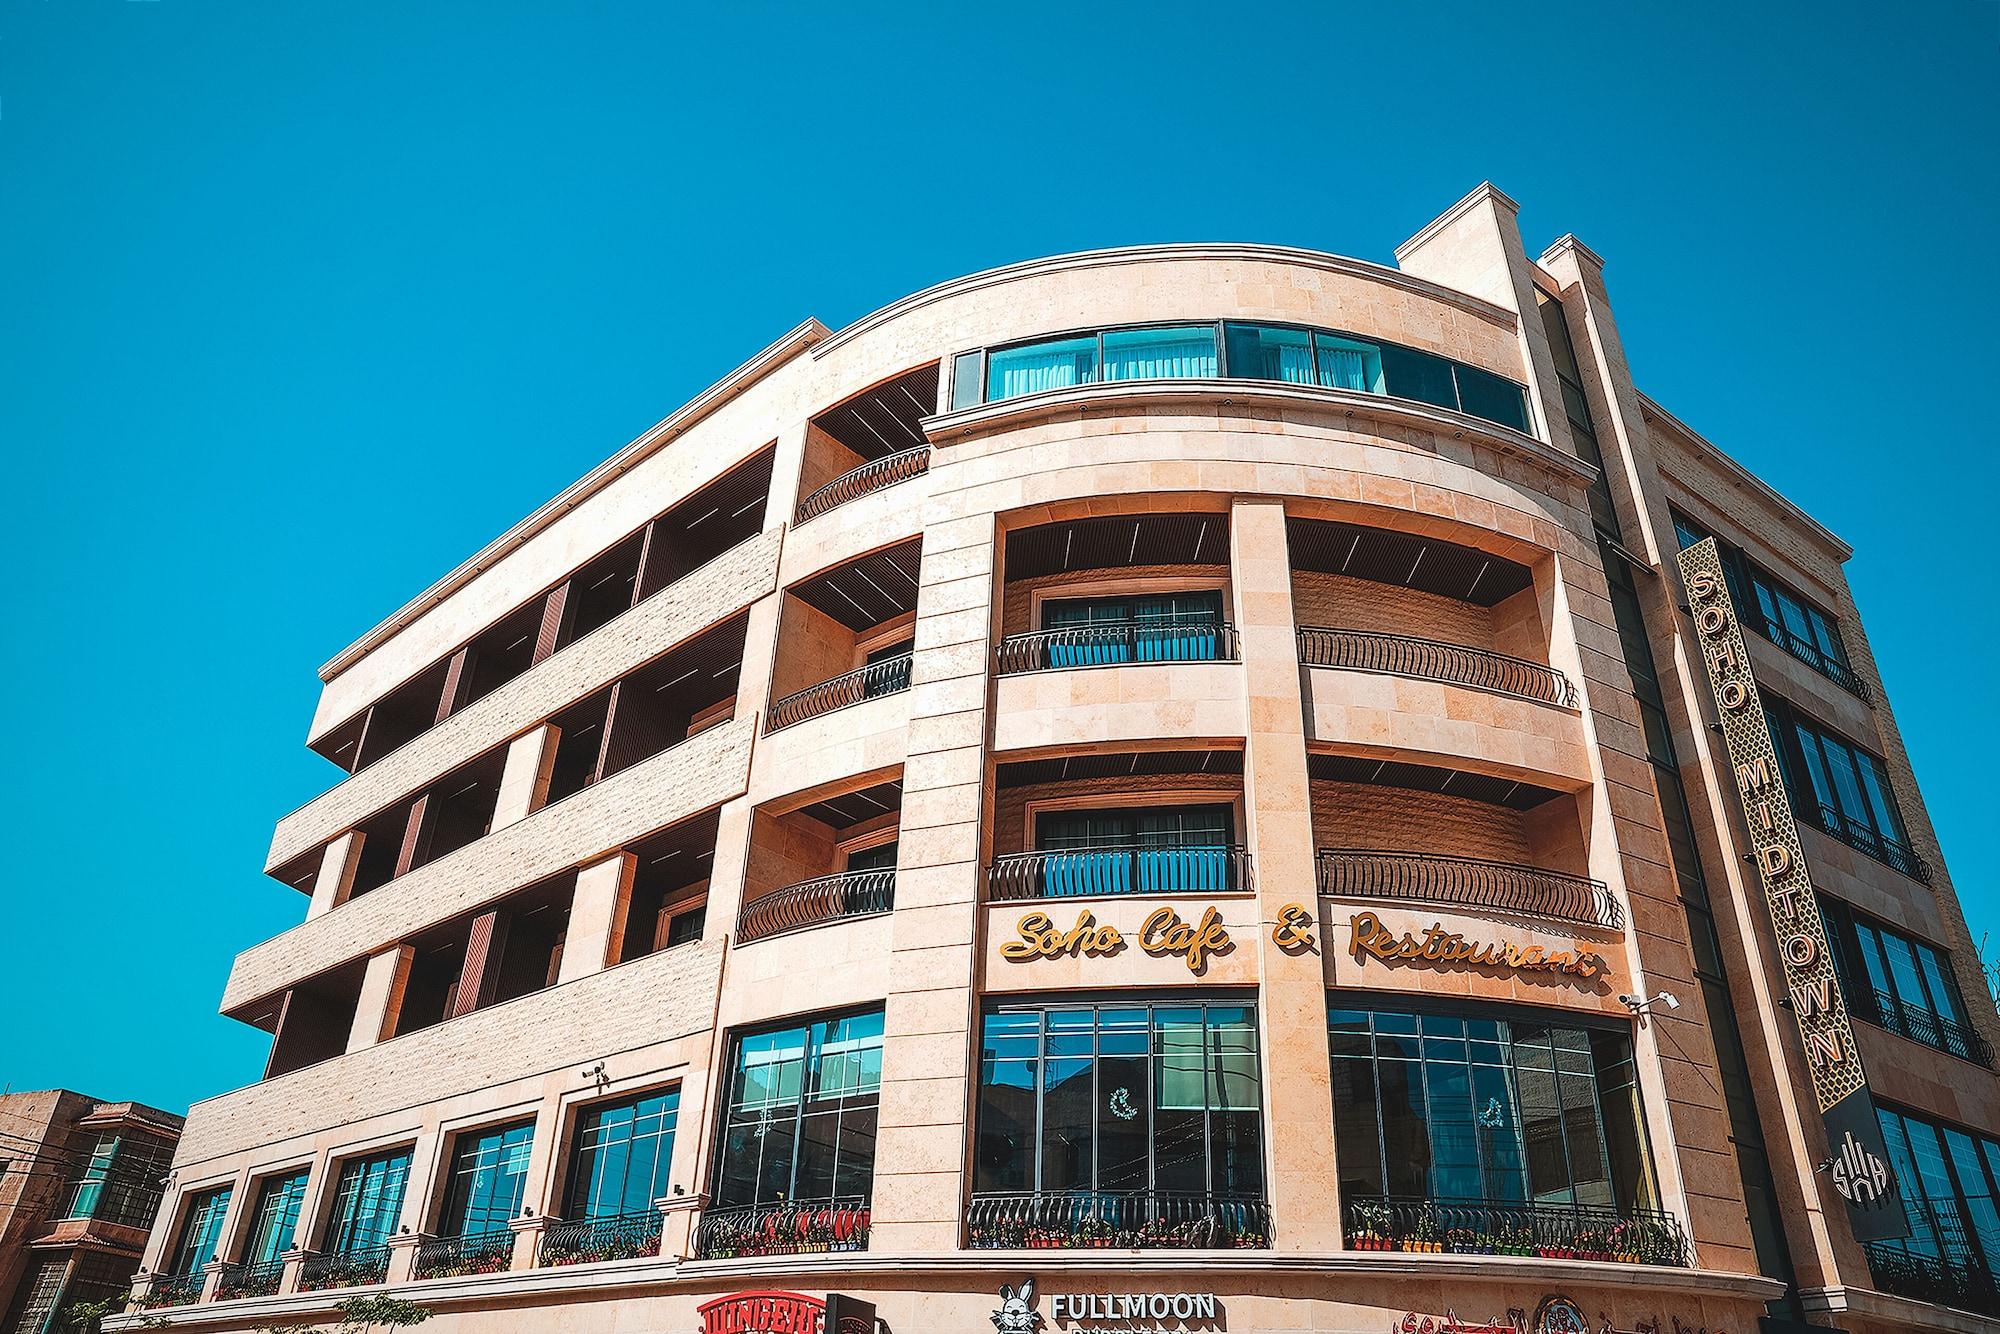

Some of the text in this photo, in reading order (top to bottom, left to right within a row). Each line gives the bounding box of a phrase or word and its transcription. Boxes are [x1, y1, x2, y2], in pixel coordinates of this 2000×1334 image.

[1690, 570, 1846, 1068] SOHO MIDTOWN
[1000, 902, 1600, 978] Soho Cafe & Restaurant
[1051, 1292, 1216, 1320] FULLMOON
